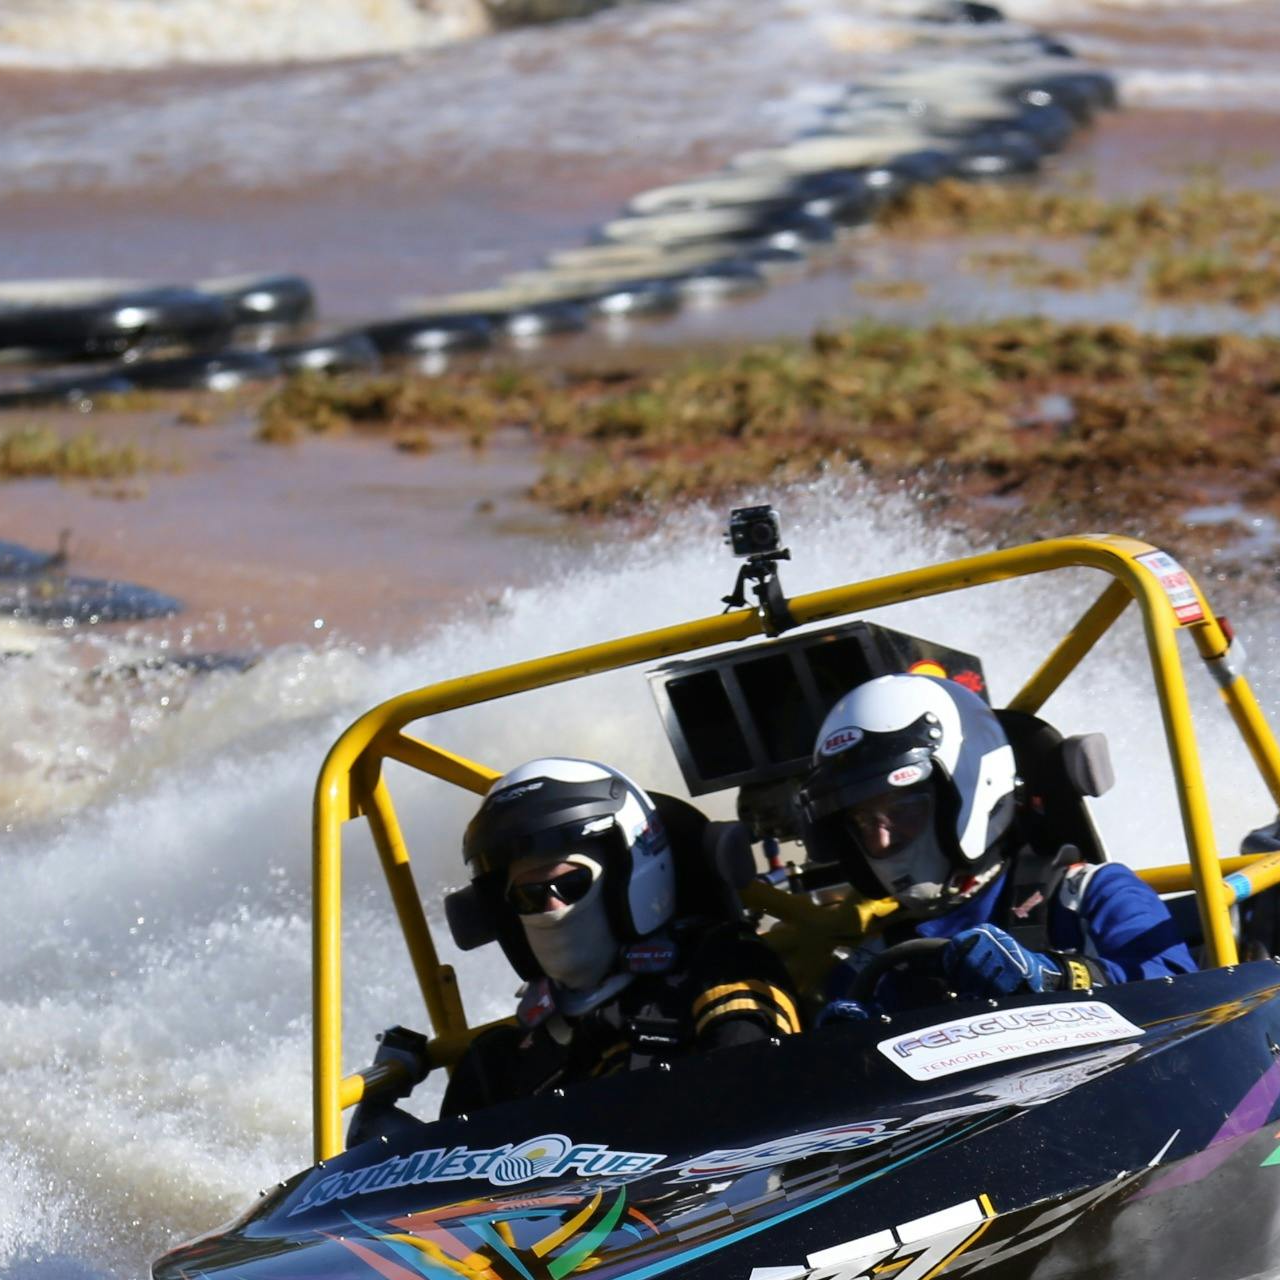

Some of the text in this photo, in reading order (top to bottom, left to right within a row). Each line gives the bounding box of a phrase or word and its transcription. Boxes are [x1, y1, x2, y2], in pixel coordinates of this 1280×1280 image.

[825, 731, 856, 751] BELL
[893, 769, 919, 782] BELL
[893, 1005, 1113, 1057] FERGUSON
[919, 1049, 993, 1074] TEMORA
